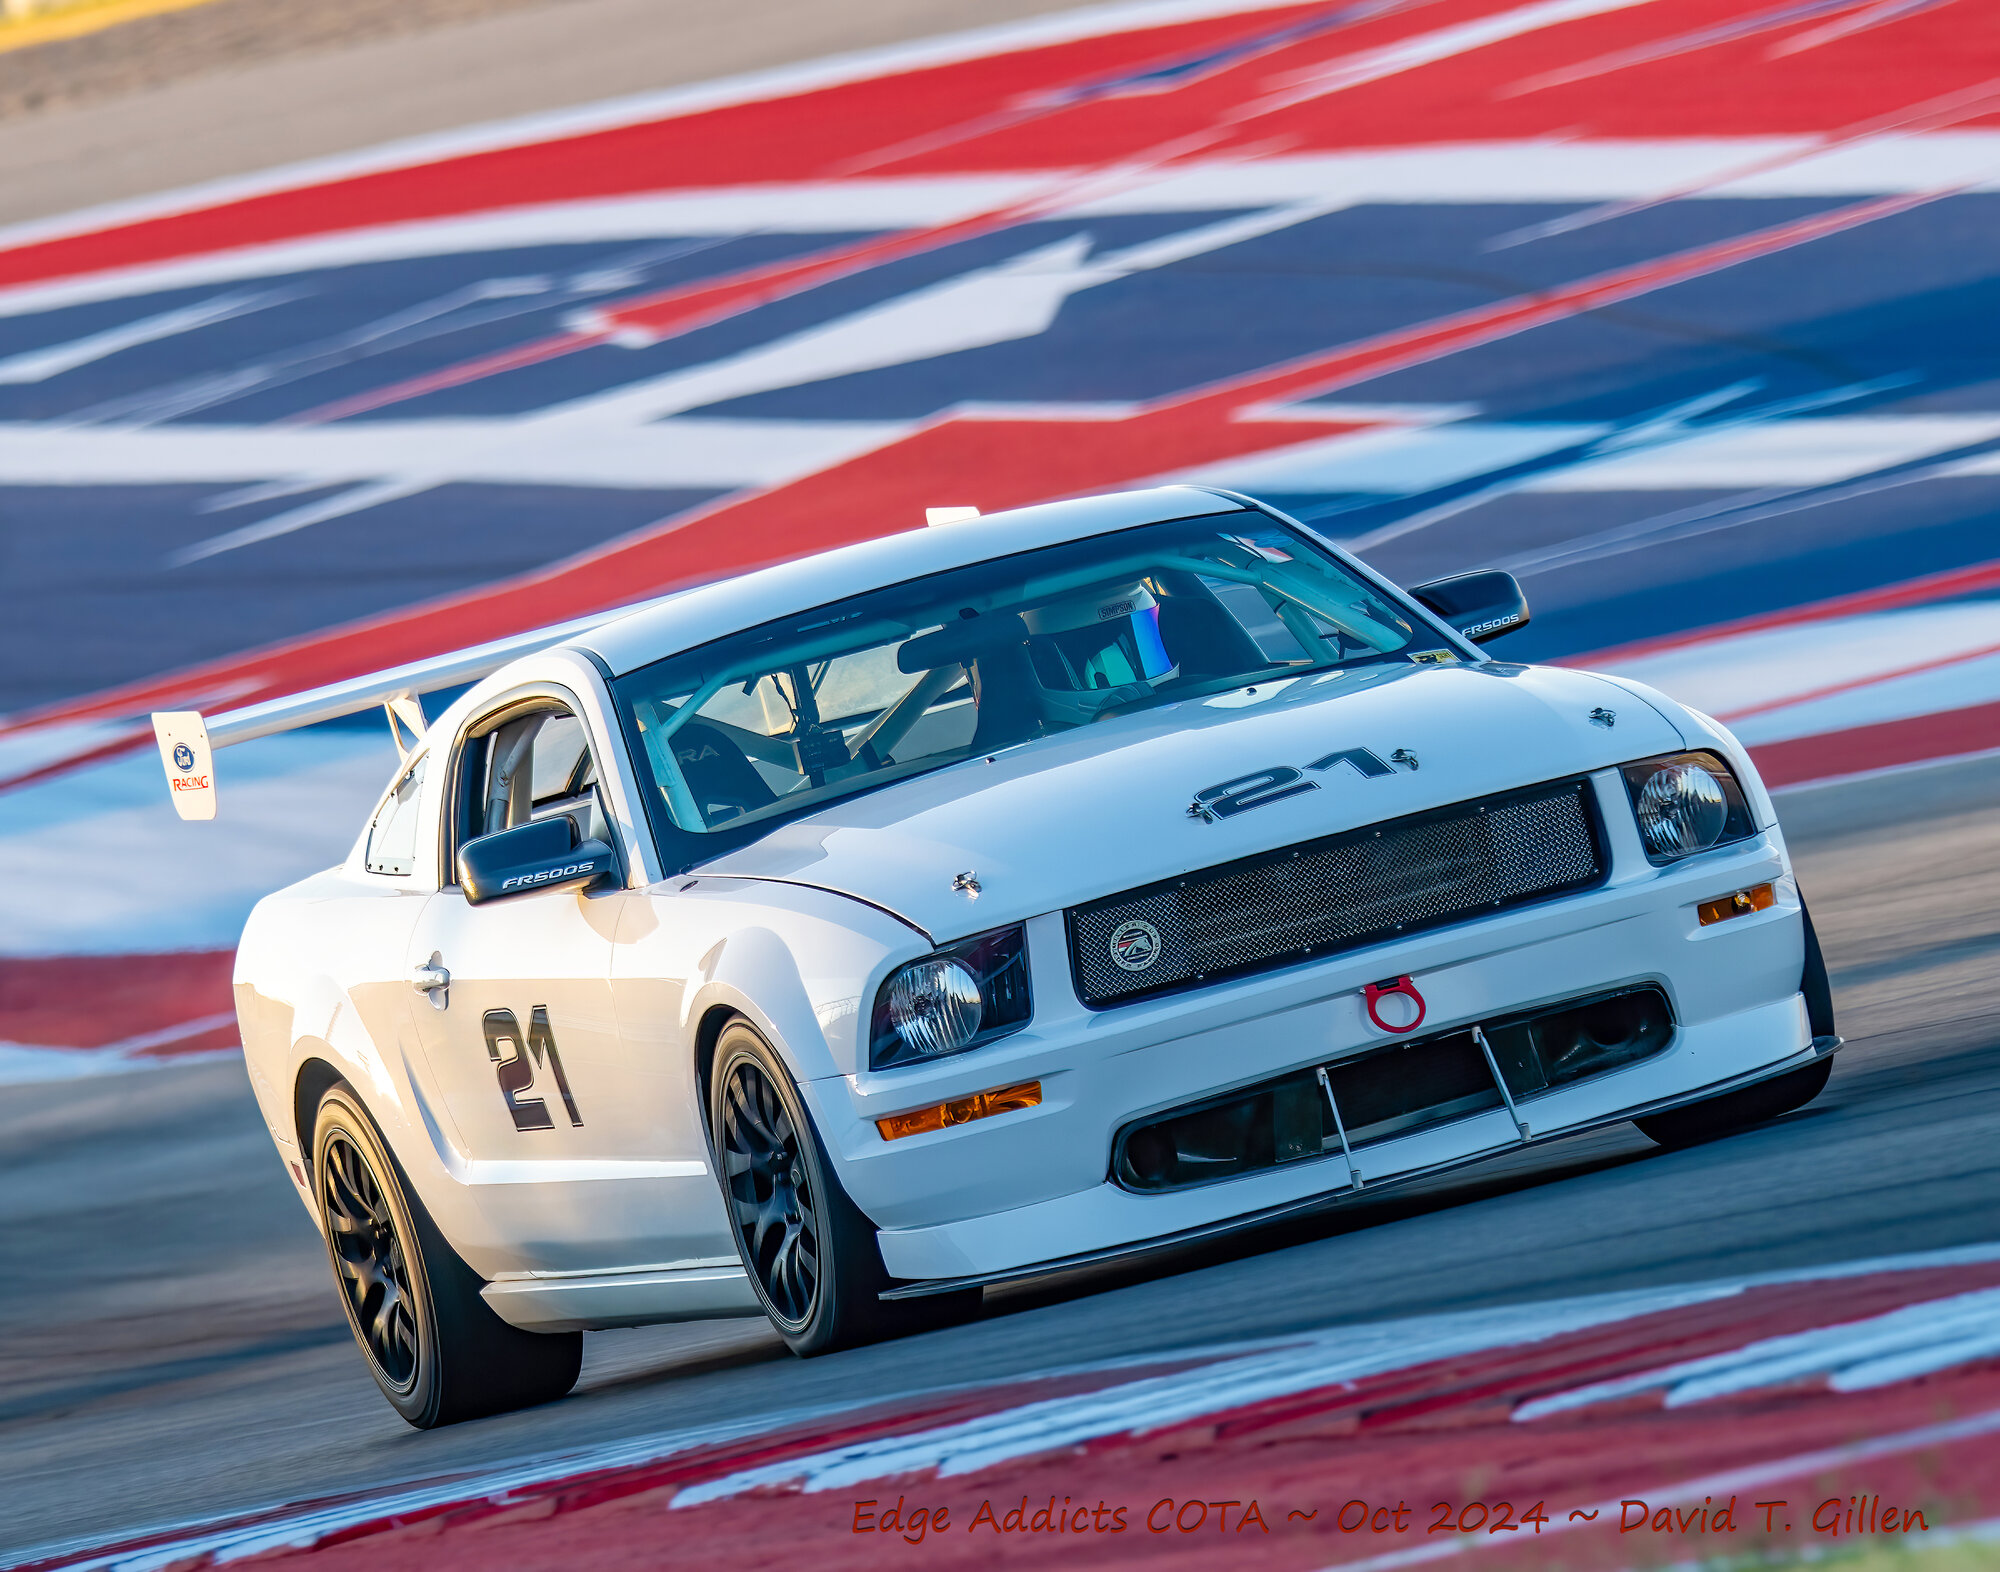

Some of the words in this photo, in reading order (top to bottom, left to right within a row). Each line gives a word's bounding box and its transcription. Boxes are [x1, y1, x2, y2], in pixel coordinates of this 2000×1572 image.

[1101, 601, 1133, 617] SIMPSON
[1462, 613, 1519, 637] FR500S
[173, 775, 208, 791] RACING
[1194, 746, 1397, 820] 21
[502, 861, 594, 889] FR500S
[482, 1004, 584, 1132] 21
